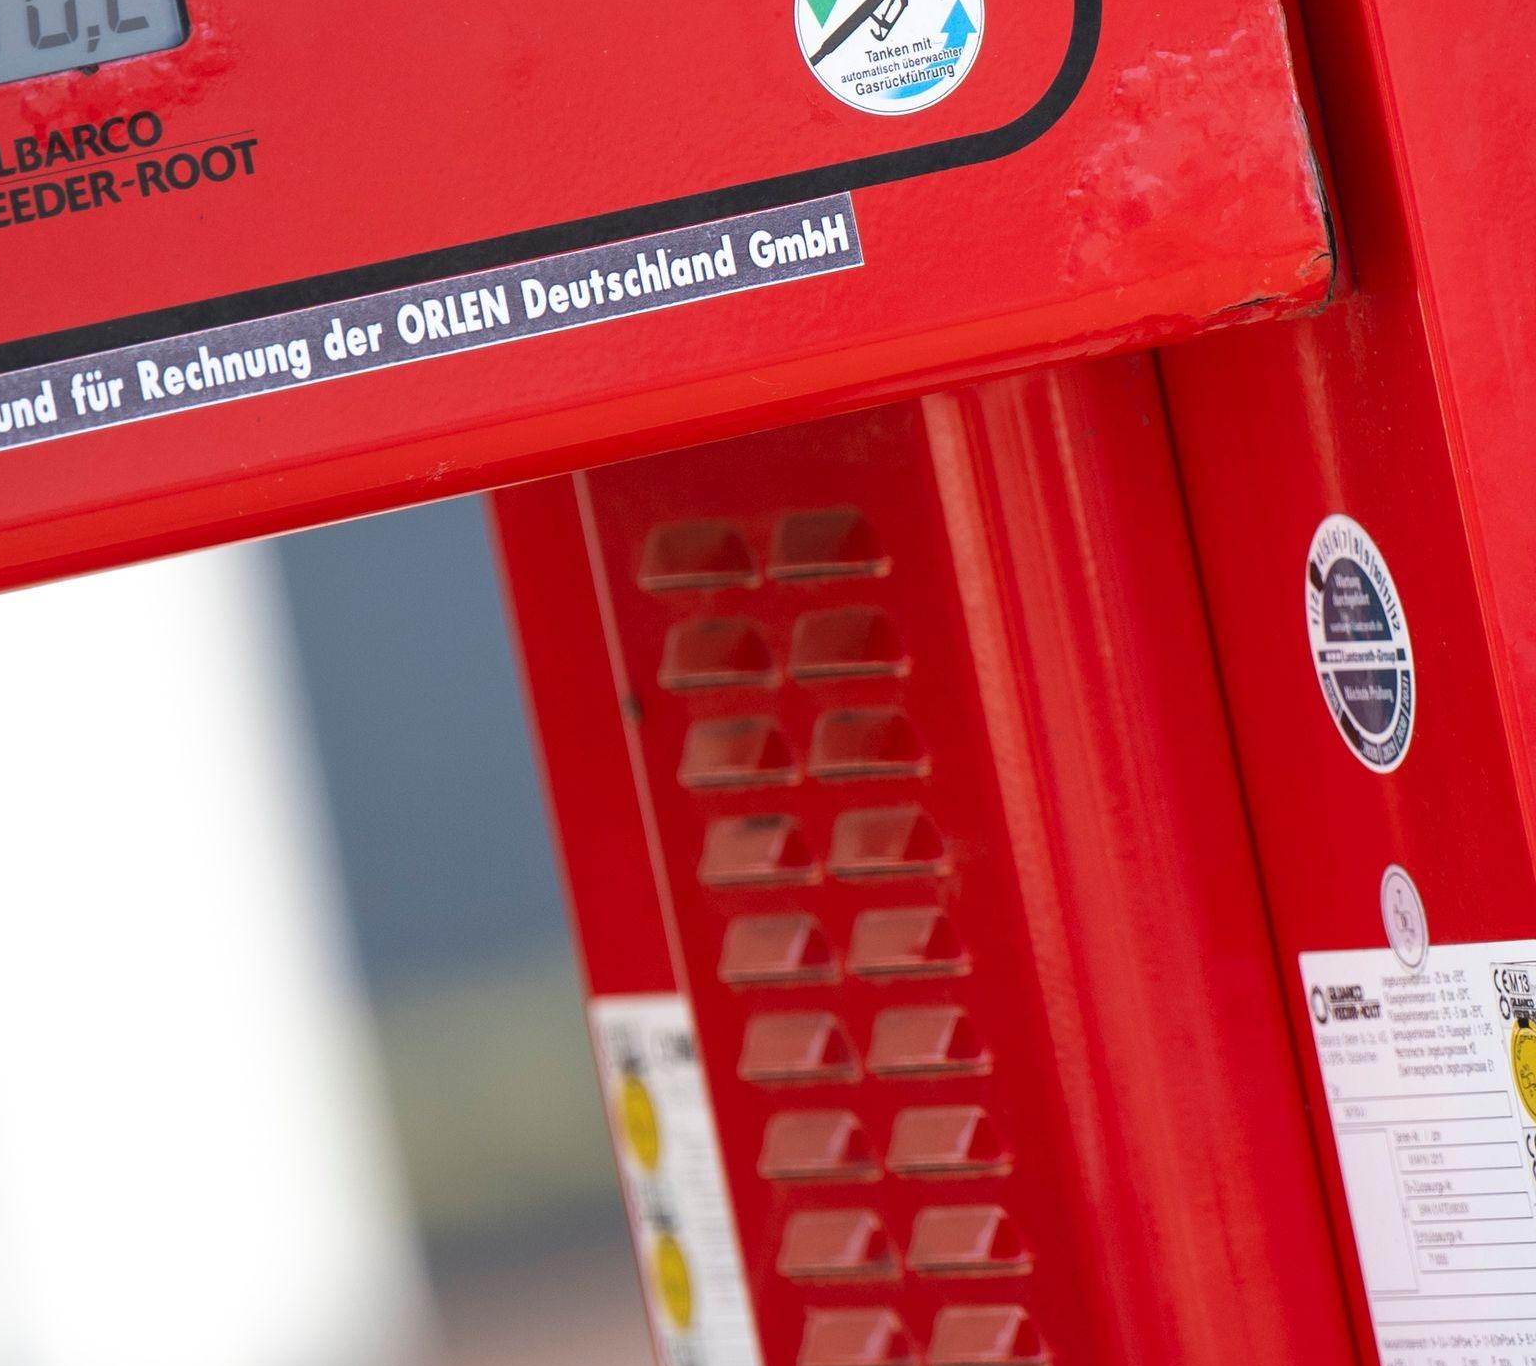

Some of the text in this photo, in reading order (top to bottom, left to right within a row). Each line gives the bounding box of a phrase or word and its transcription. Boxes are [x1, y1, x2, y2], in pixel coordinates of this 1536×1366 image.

[841, 47, 963, 83] automatisch überwachter
[865, 37, 932, 63] Tanken mit
[855, 65, 955, 96] Gasrückführung
[71, 369, 125, 419] für
[137, 339, 312, 401] Rechnung
[323, 317, 384, 361] der
[396, 284, 512, 344] ORLEN
[520, 234, 737, 319] Deutschland
[748, 212, 851, 269] GmbH
